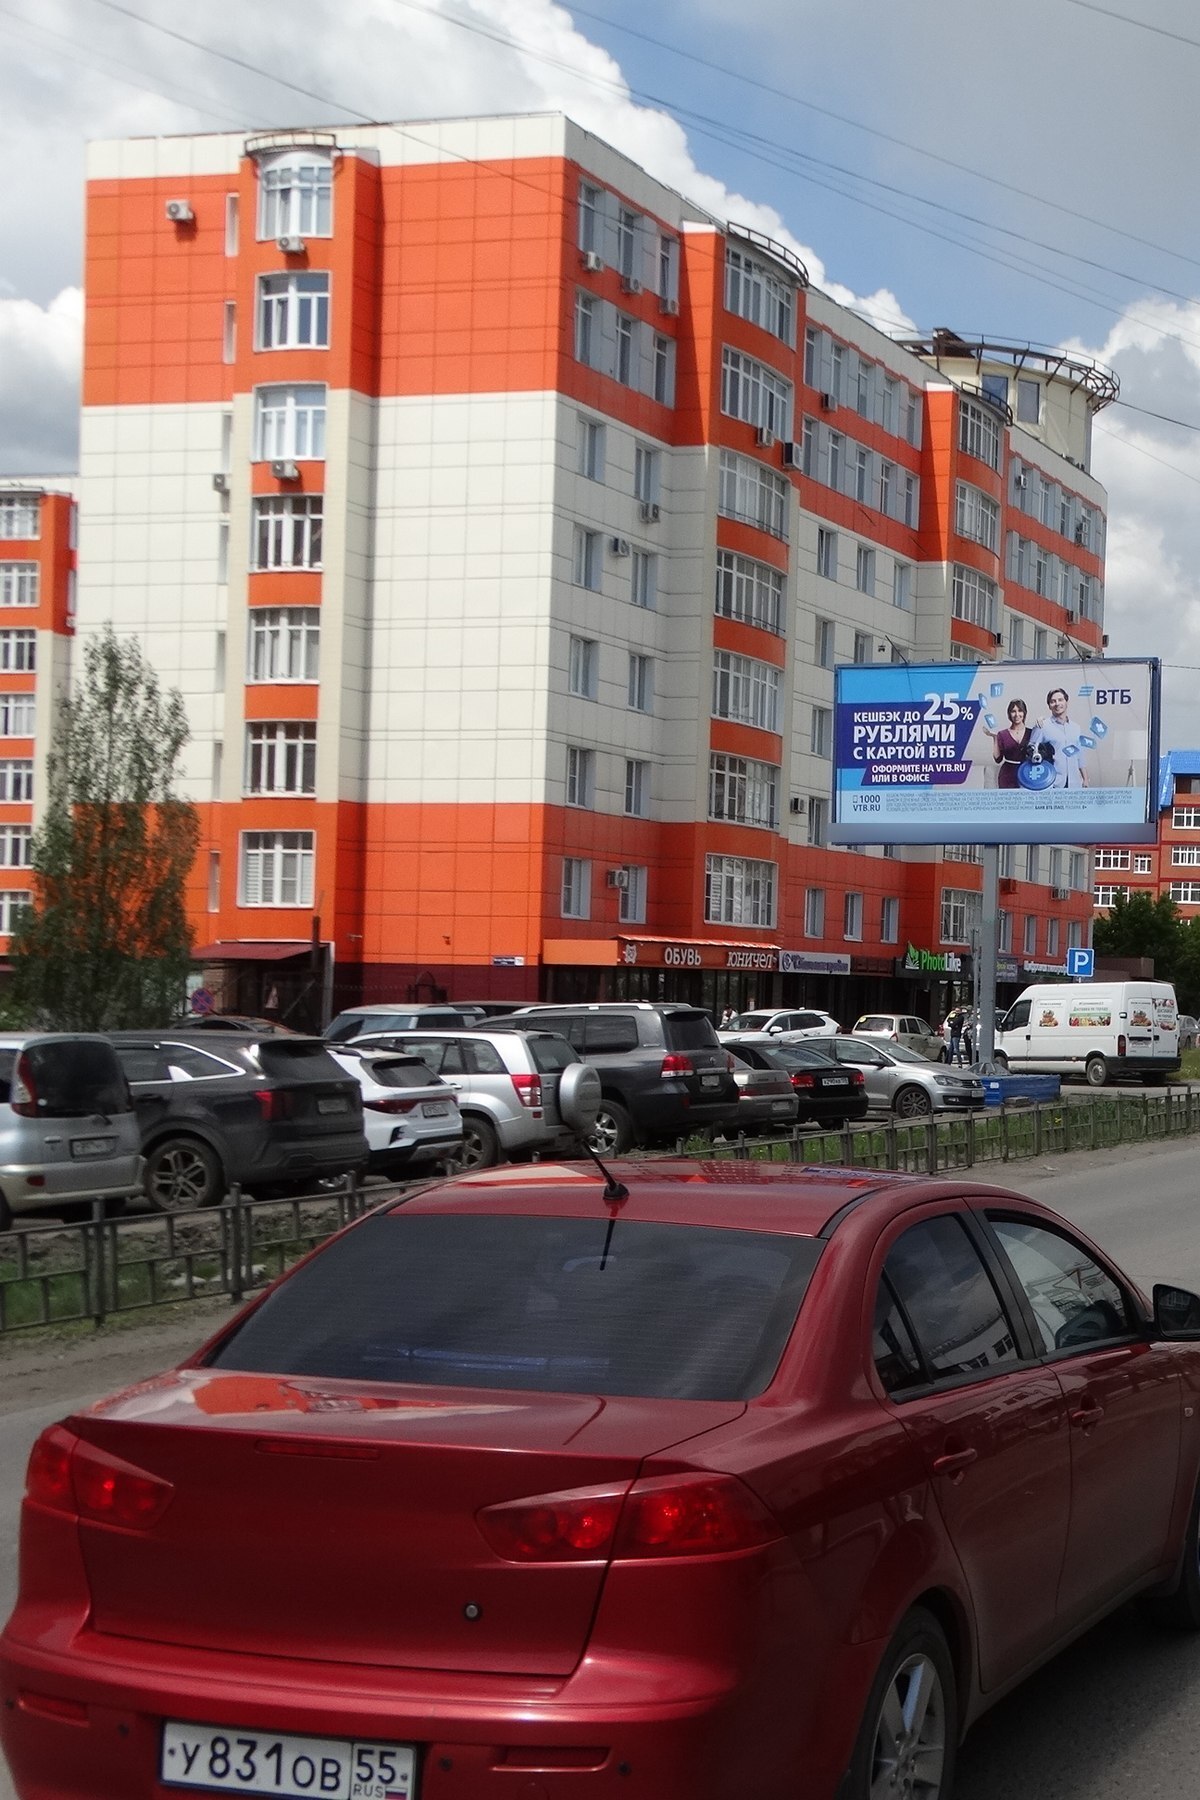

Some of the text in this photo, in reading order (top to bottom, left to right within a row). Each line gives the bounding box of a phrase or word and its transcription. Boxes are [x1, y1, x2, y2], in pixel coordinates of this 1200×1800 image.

[1095, 688, 1132, 706] ВТБ
[853, 692, 974, 723] КЕШБЭК ДО 25%
[853, 724, 956, 744] РУБЛЯМИ
[853, 743, 956, 760] С КАРТОЙ ВТБ
[871, 763, 966, 774] ОФОРМИТЕ НА VTB.RU
[871, 773, 930, 783] ИЛИ В ОФИСЕ
[859, 794, 881, 804] 1000
[852, 804, 881, 812] VTB.RU
[664, 946, 702, 967] ОБУВЬ
[1074, 951, 1090, 973] P
[180, 1735, 398, 1793] У831ОВ 55
[353, 1783, 385, 1799] RUS
